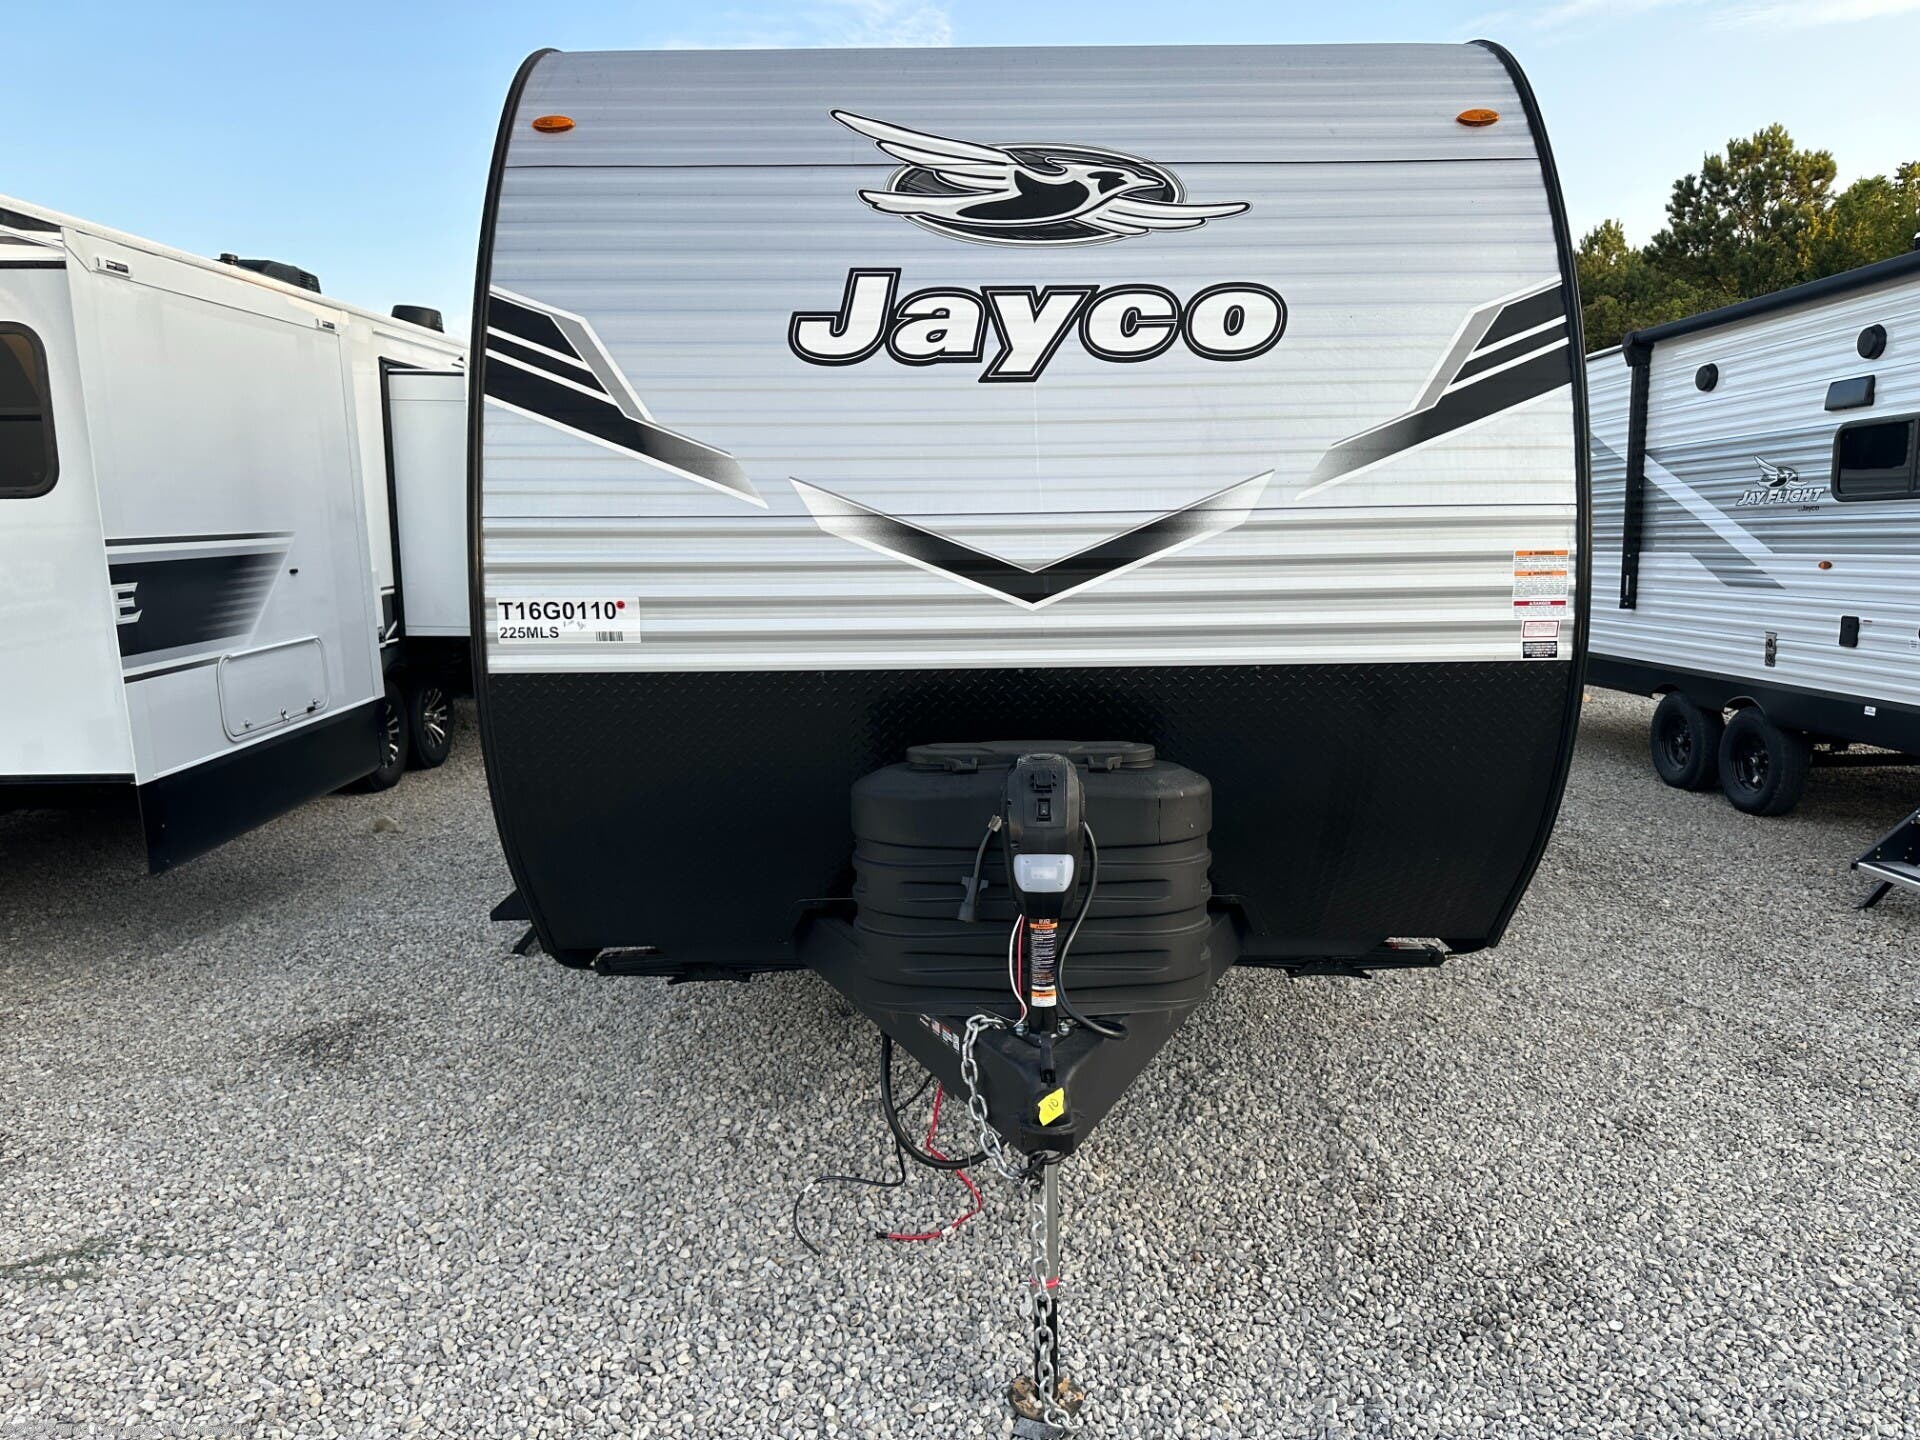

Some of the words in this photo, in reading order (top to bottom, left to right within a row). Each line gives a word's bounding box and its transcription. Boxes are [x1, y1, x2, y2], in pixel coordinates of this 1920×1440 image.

[787, 267, 1288, 383] Jayco
[1736, 490, 1766, 506] JAY
[1765, 487, 1826, 504] FLIGHT
[498, 602, 617, 620] T16G0110
[499, 626, 560, 639] 225MLS
